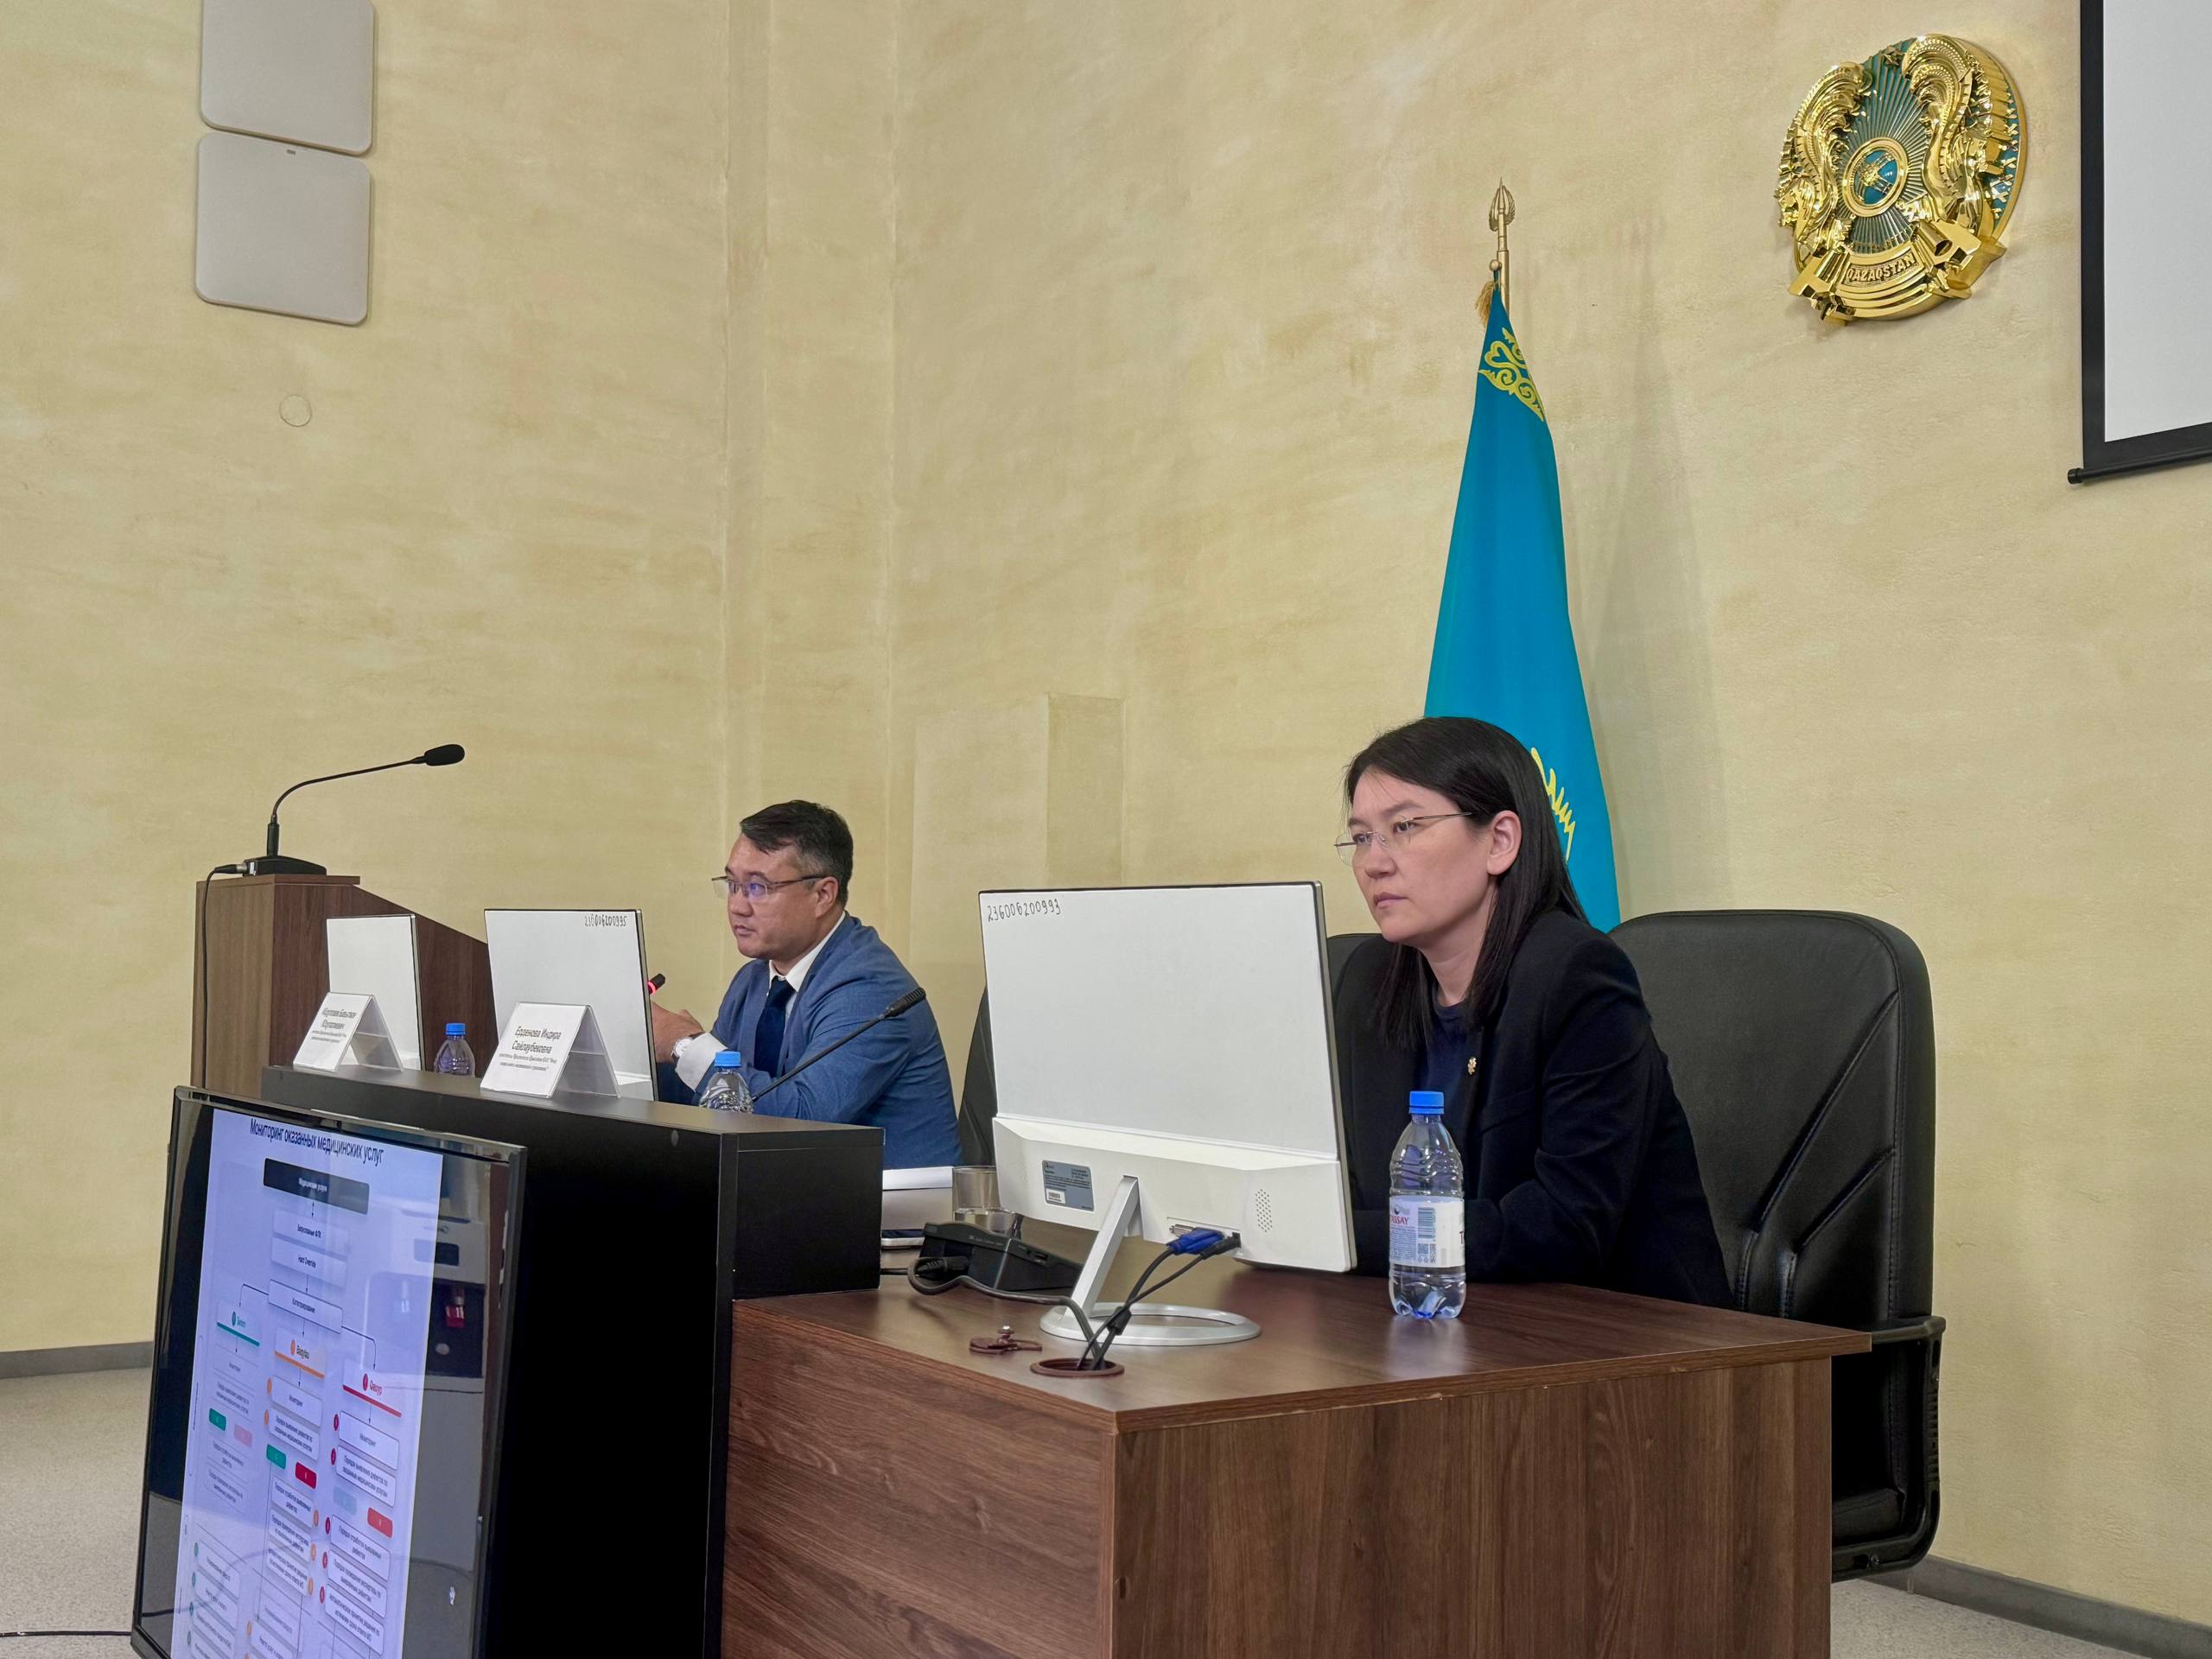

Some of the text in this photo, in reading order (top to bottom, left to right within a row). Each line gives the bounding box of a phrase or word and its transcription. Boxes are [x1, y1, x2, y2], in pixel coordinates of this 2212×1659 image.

[1846, 251, 1916, 283] QAZAQSTAN
[250, 1118, 385, 1166] Мониторинг оказанных медицинских услуг
